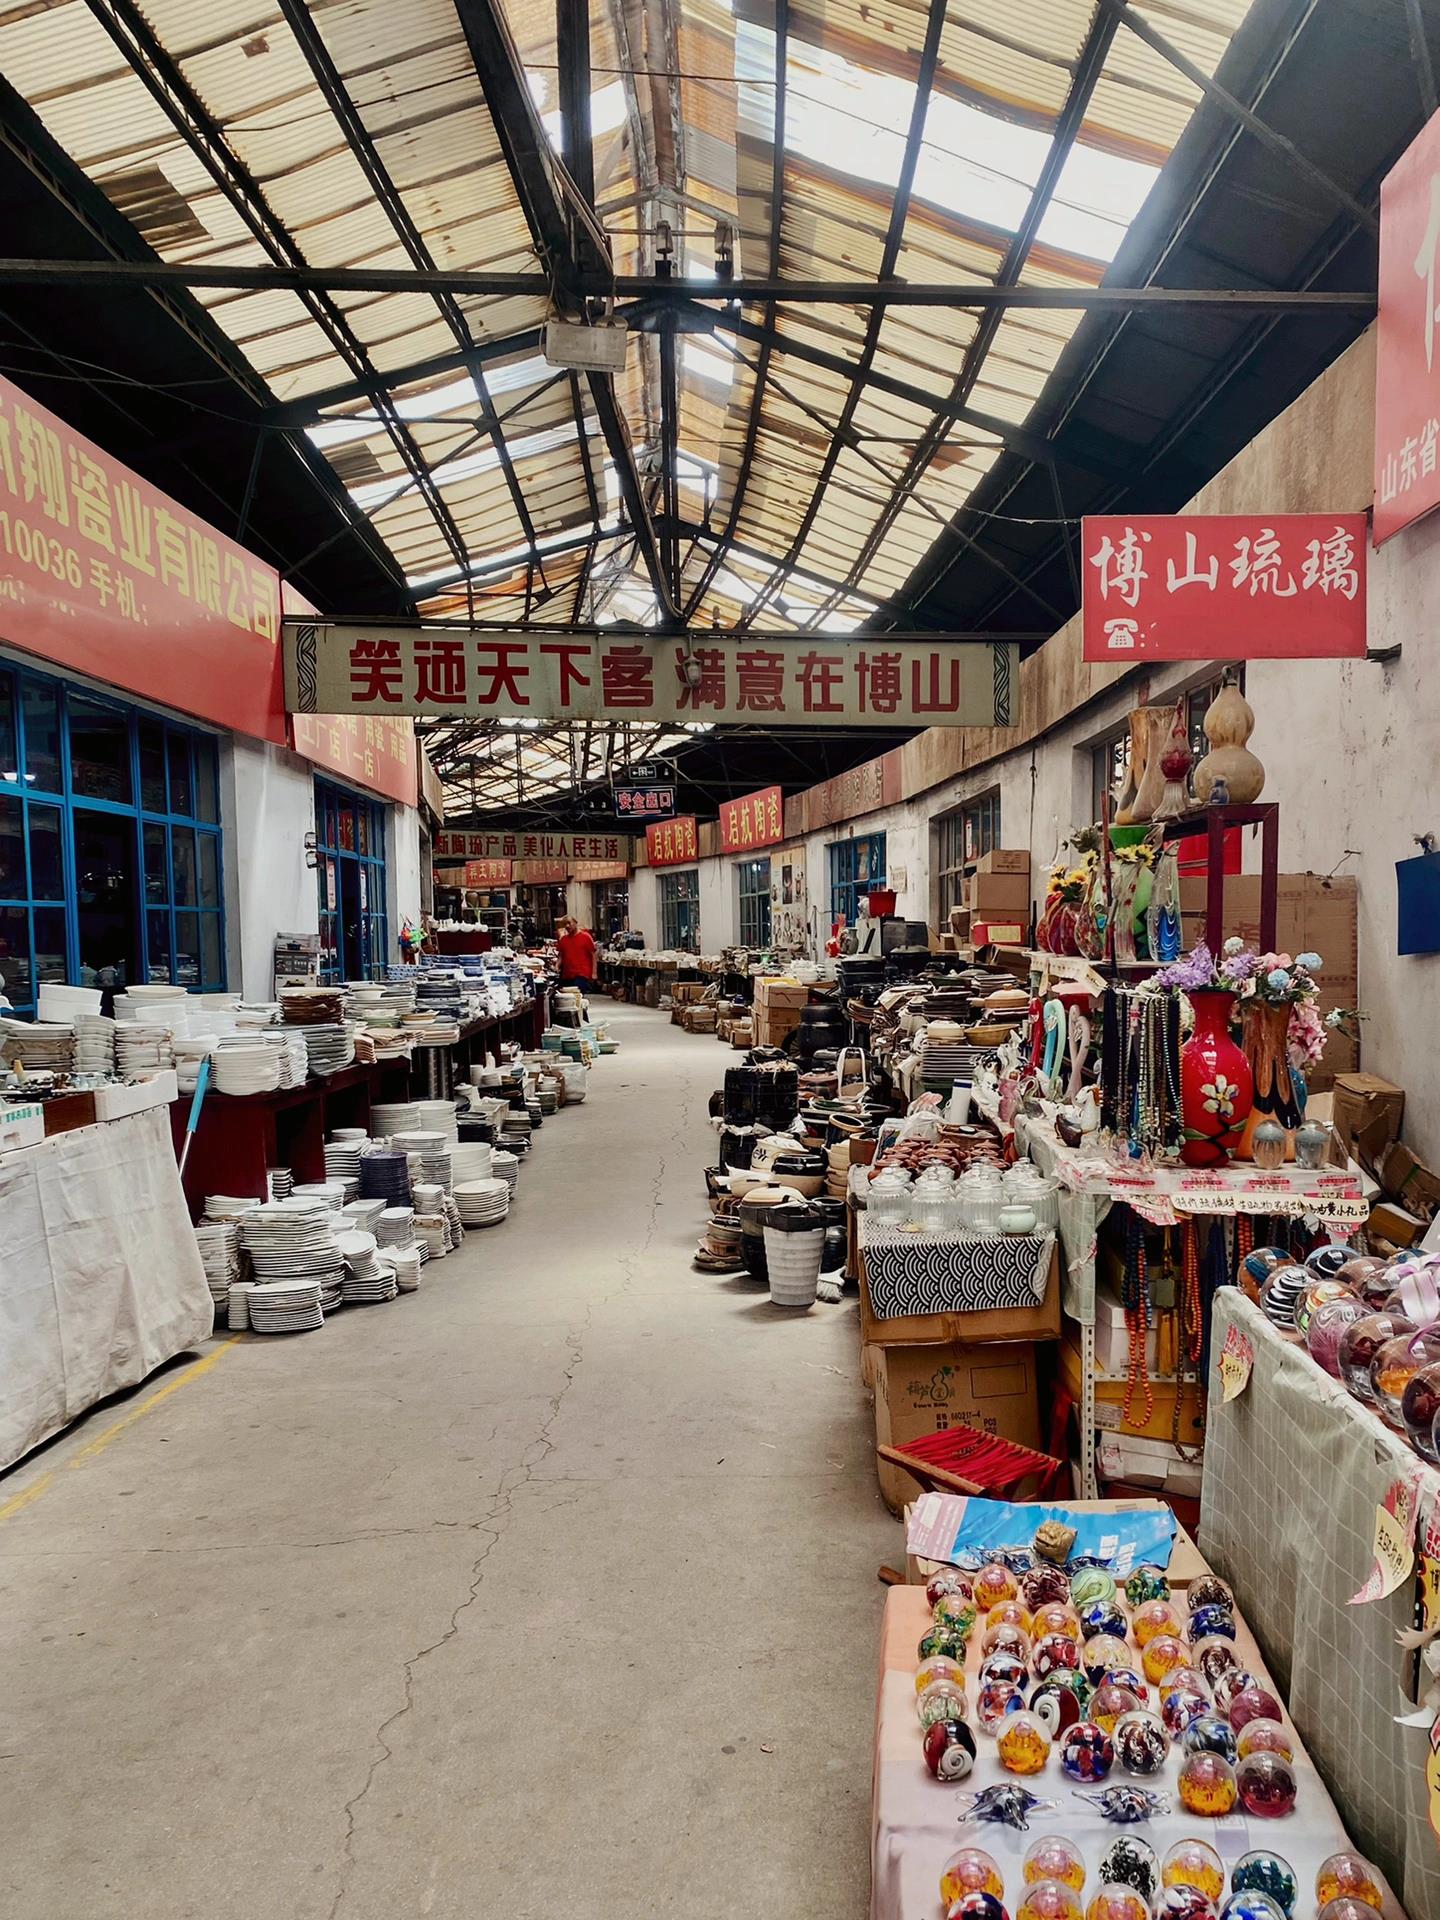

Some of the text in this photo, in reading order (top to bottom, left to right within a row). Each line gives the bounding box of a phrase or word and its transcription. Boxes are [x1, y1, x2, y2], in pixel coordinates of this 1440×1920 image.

[1381, 418, 1440, 506] 山东省
[1089, 526, 1360, 608] 博山琉璃
[618, 791, 672, 810] 安全出口
